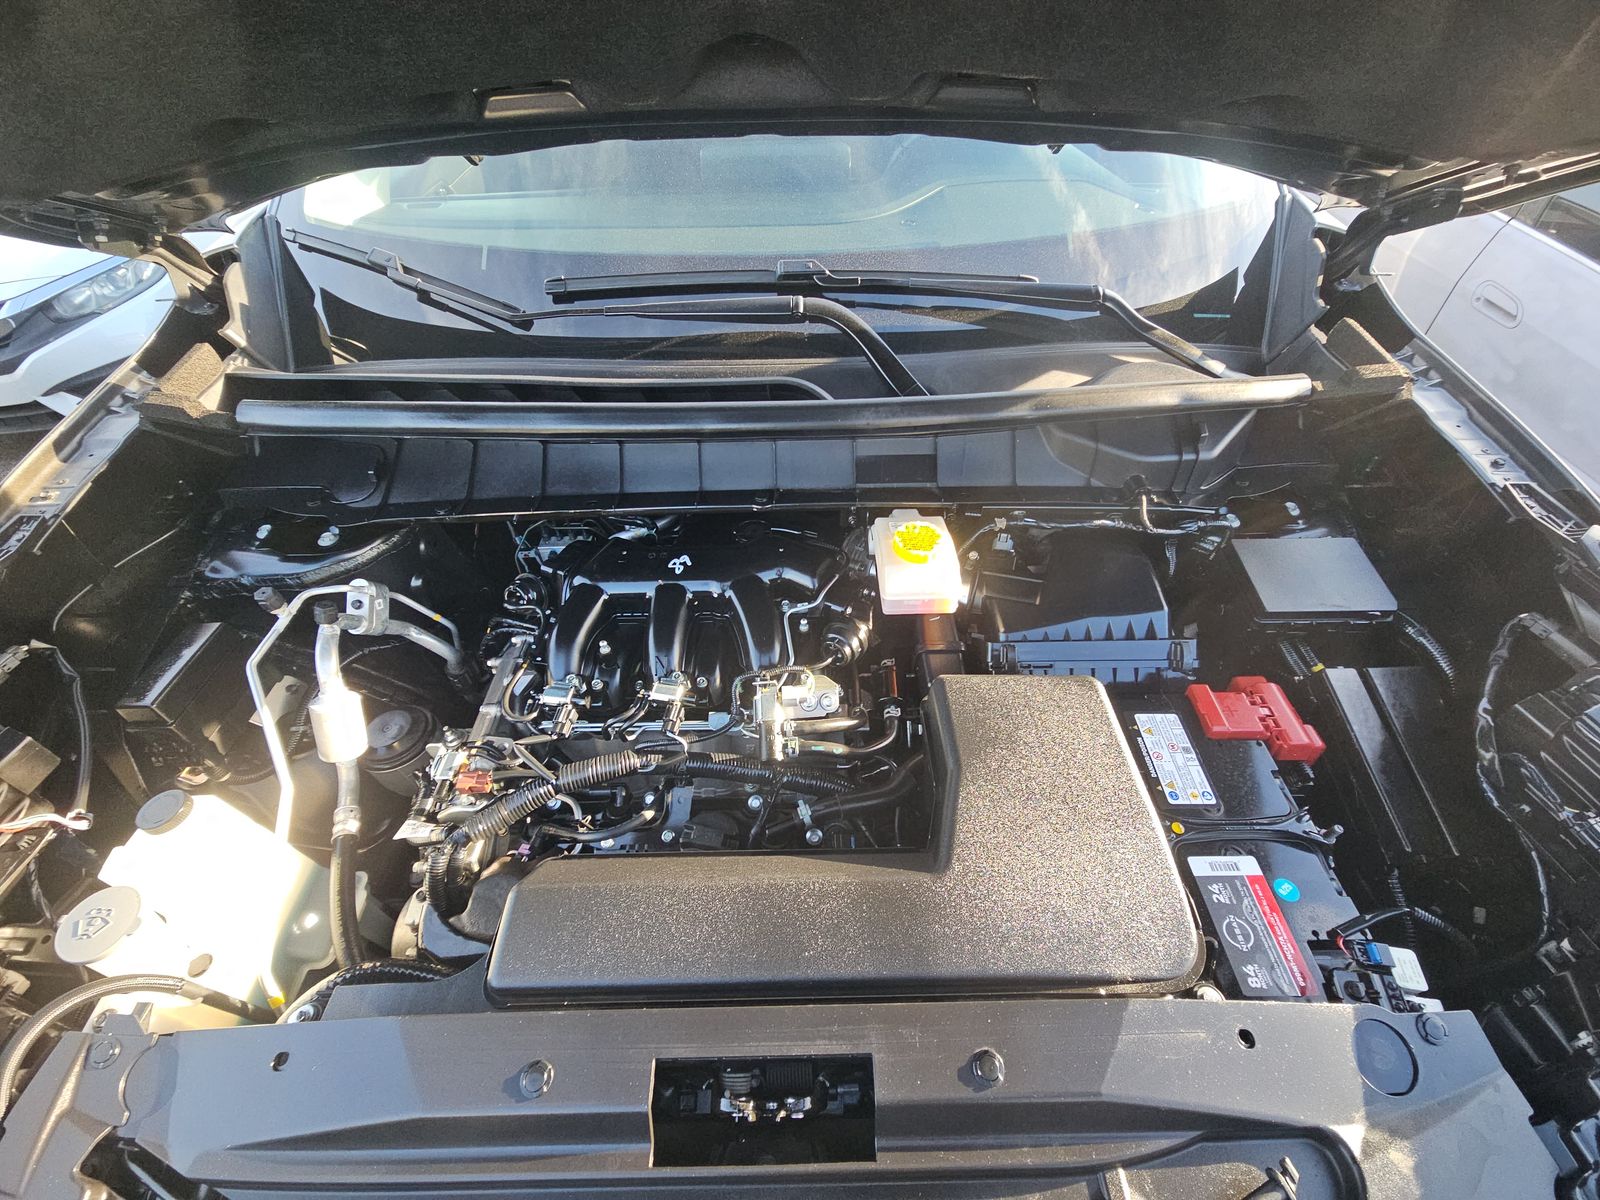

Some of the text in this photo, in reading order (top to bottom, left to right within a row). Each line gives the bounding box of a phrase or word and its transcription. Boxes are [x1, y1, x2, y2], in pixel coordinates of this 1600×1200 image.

[1207, 883, 1226, 903] 24
[1217, 882, 1231, 905] MONTH
[1228, 914, 1249, 952] NISSAN
[1242, 964, 1261, 988] 84
[1253, 964, 1268, 989] MONTH
